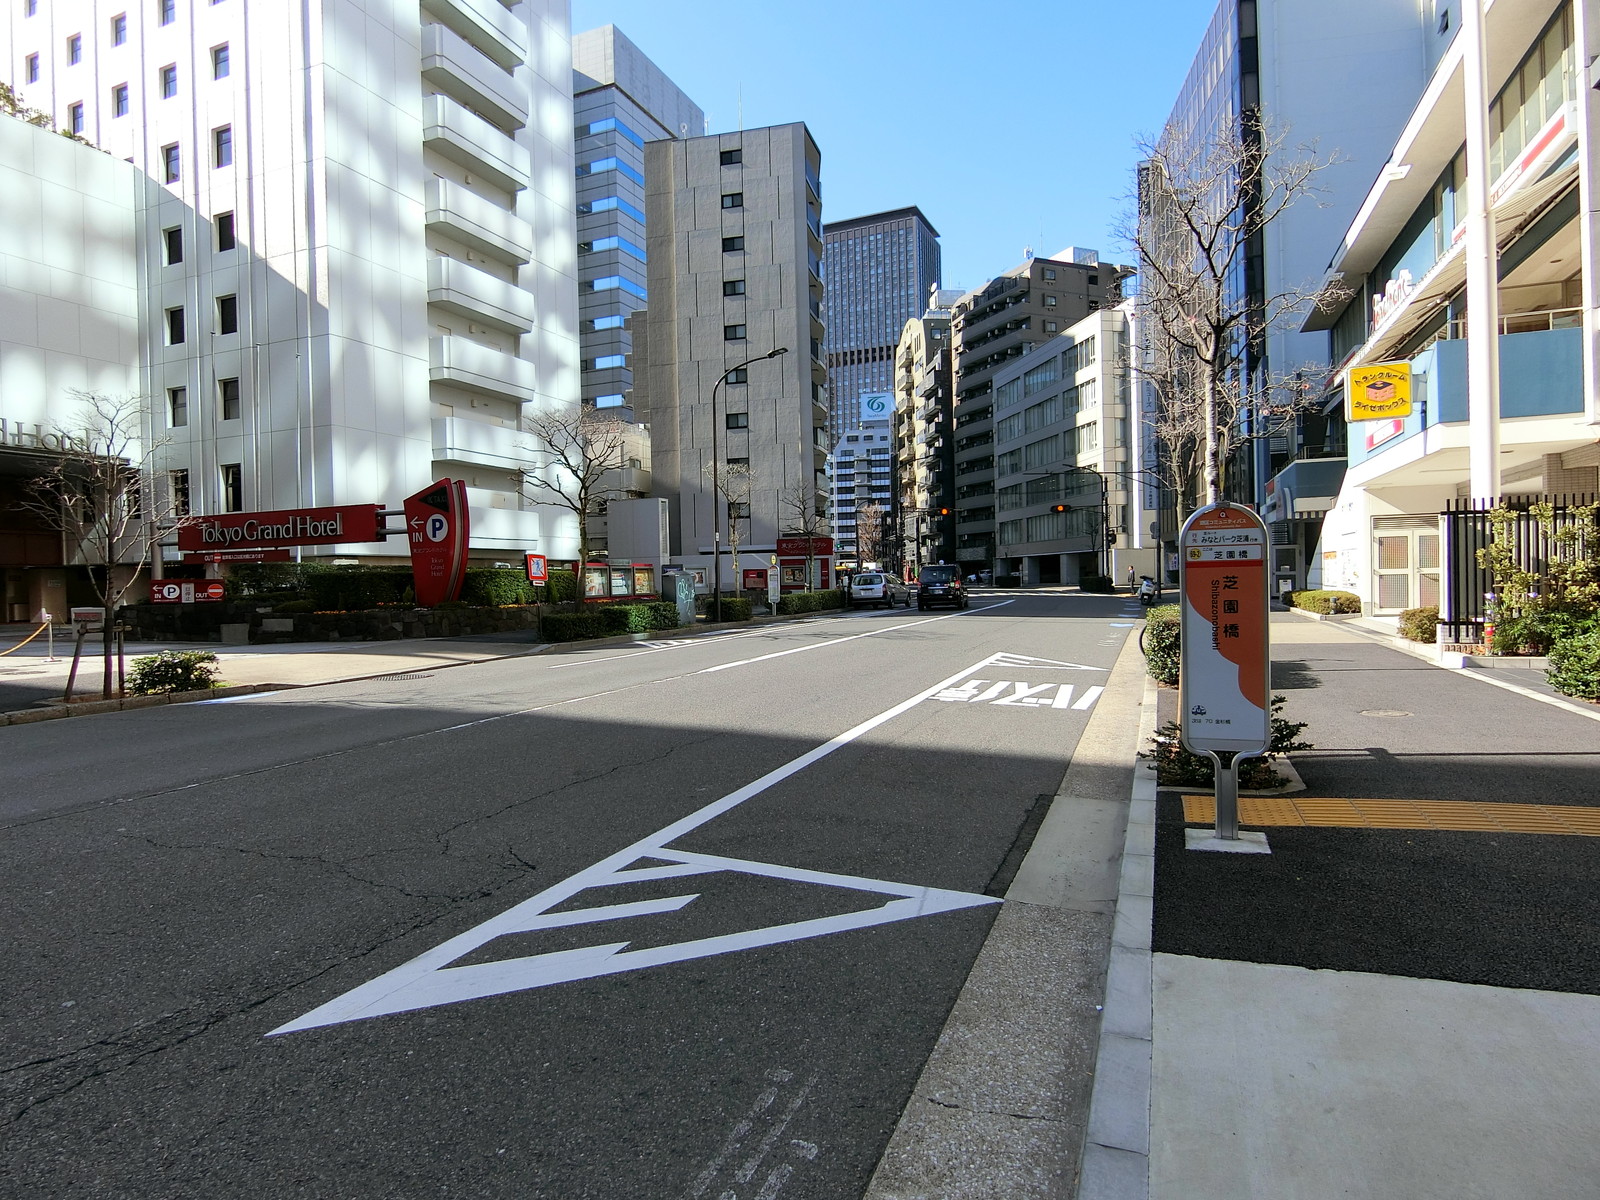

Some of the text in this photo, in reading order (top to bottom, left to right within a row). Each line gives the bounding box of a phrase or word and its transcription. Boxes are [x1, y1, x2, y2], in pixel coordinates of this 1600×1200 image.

[1354, 372, 1406, 386] トランクルーム
[200, 512, 343, 546] Tokyo Grand Hotel
[431, 518, 444, 538] P
[412, 532, 423, 543] IN
[1213, 550, 1248, 559] 芝園橋
[167, 586, 177, 597] P
[1211, 579, 1221, 650] Shibazonobashi
[1223, 575, 1239, 638] 芝園橋
